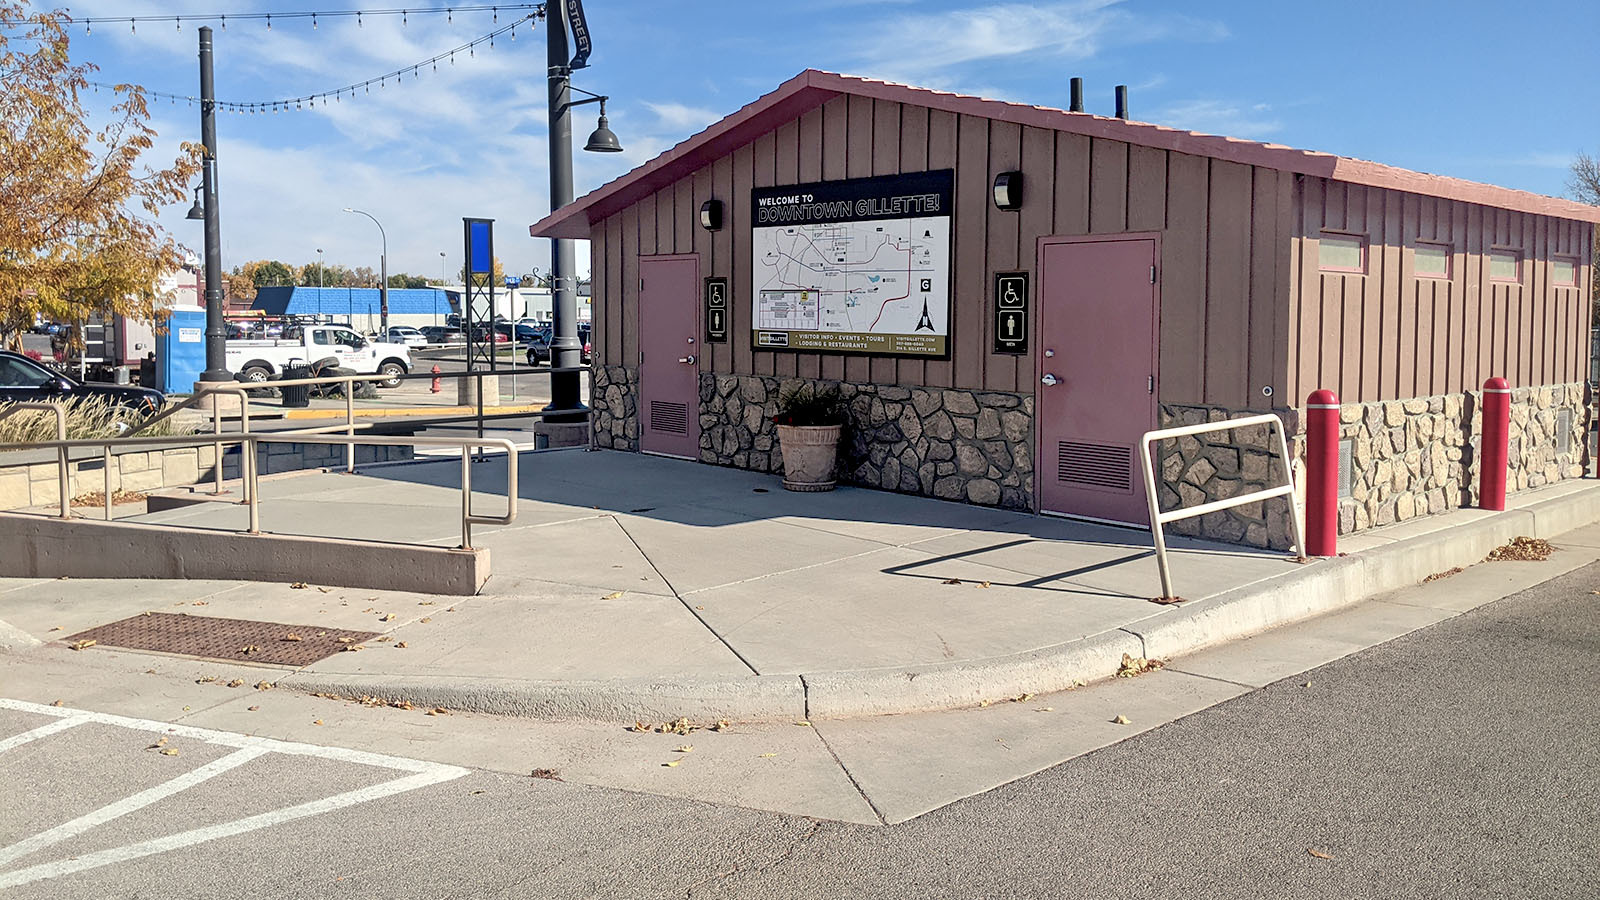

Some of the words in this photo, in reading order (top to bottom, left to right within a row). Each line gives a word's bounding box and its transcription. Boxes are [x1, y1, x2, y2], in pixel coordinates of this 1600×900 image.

[568, 0, 589, 52] STREET
[758, 195, 800, 206] WELCOME
[802, 194, 813, 203] TO
[758, 201, 852, 223] DOWNTOWN
[855, 193, 940, 216] GILLETTE!
[921, 280, 929, 289] G
